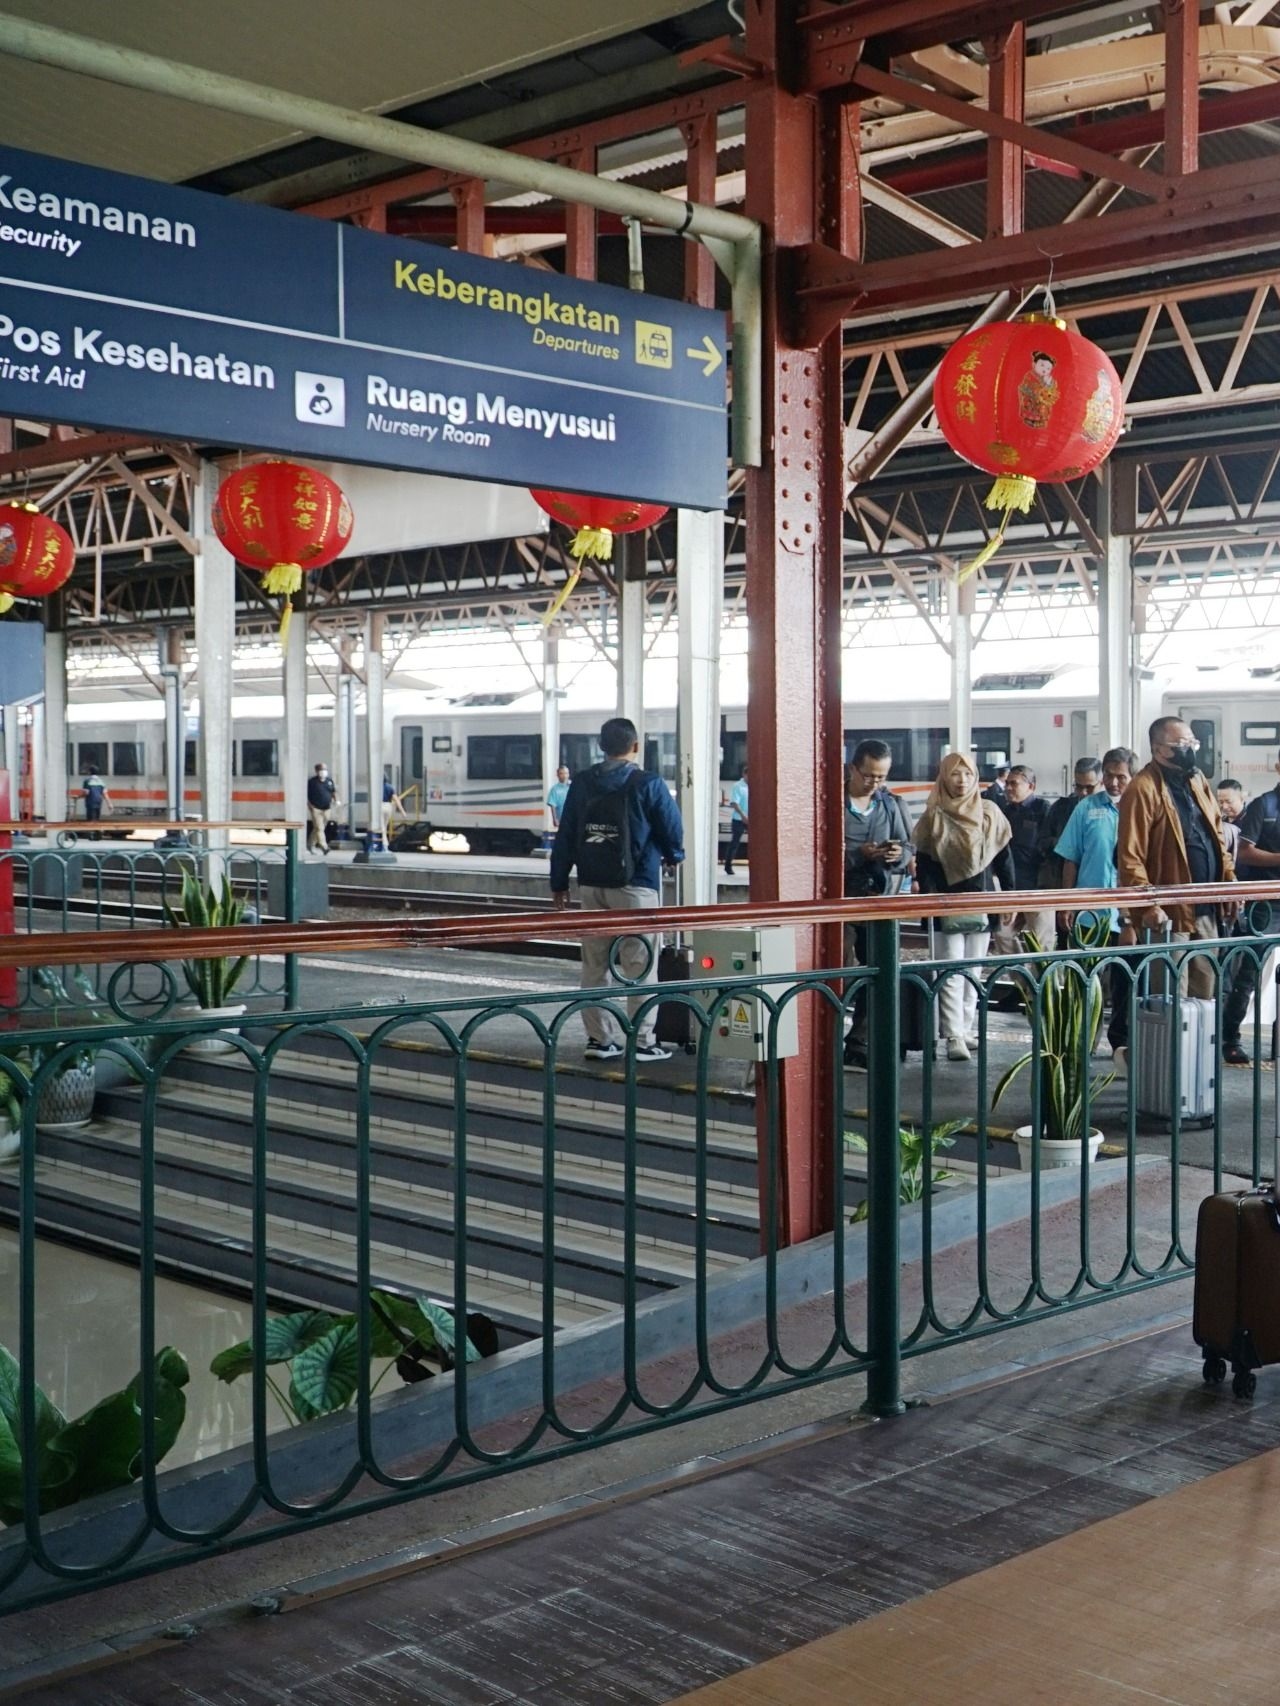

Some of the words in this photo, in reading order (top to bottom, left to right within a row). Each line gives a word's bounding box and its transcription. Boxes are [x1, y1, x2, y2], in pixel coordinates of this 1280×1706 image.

[0, 221, 82, 258] ecurity
[394, 259, 620, 335] Keberangkatan
[74, 325, 275, 389] Kesehatan
[532, 327, 620, 360] Departures
[0, 357, 41, 383] irst
[44, 364, 86, 390] Aid
[367, 374, 468, 425] Ruang
[476, 392, 616, 442] Menyusui
[366, 412, 439, 443] Nursery
[442, 423, 491, 447] Room
